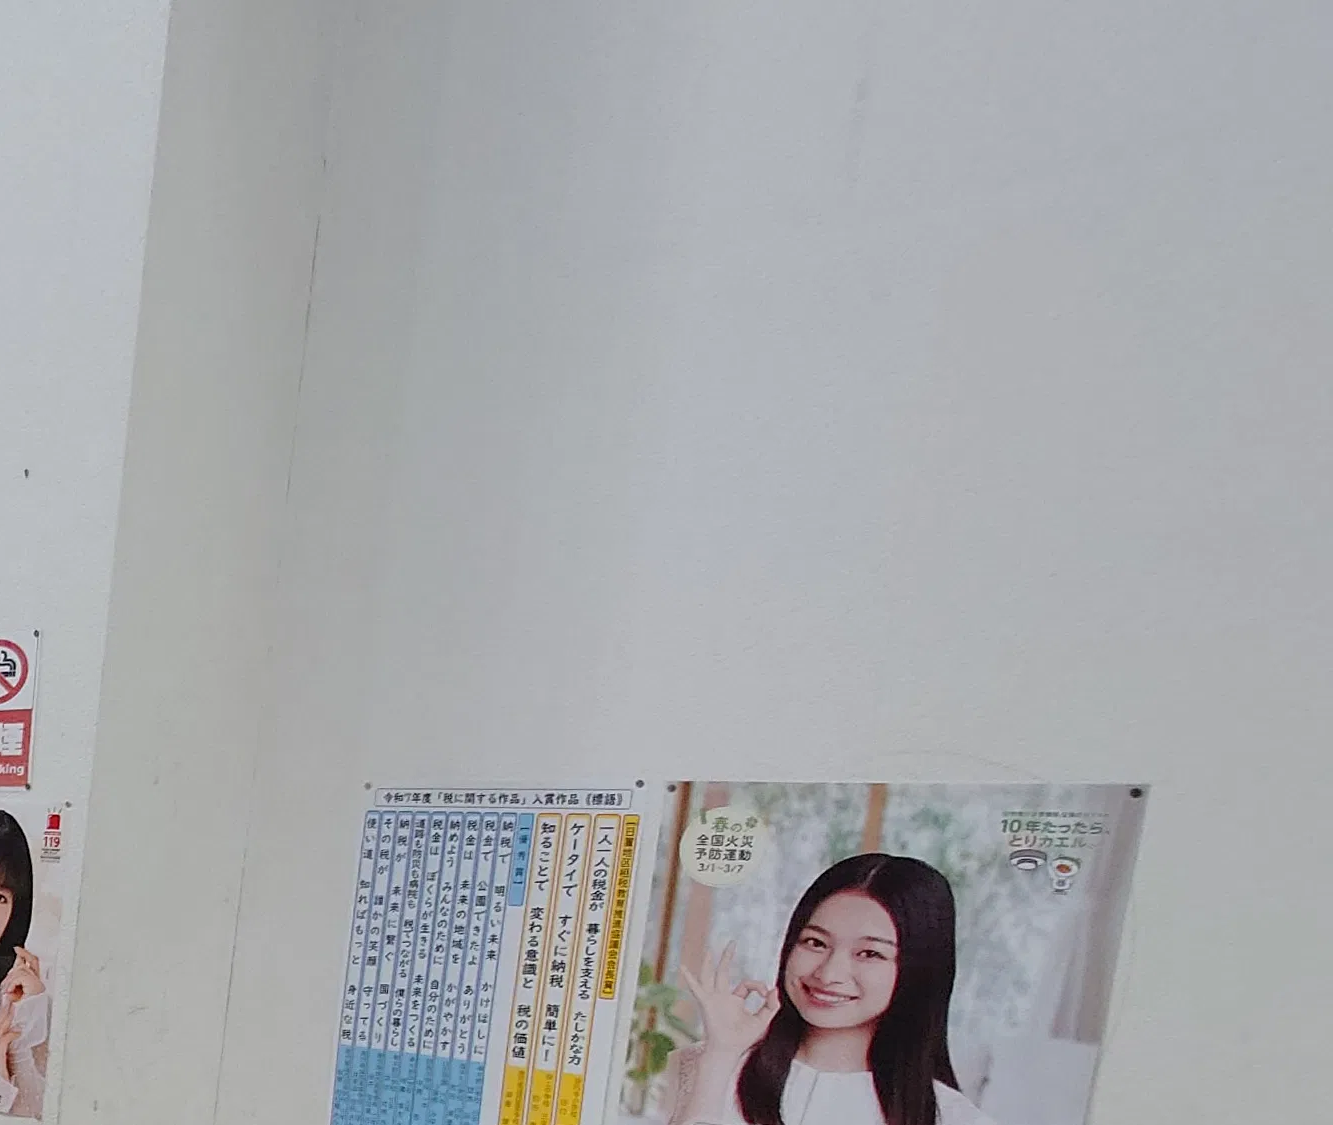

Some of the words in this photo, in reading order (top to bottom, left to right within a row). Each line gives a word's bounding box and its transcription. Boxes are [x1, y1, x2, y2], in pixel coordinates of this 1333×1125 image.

[44, 836, 60, 848] 119
[695, 848, 752, 861] 予防運動
[696, 834, 754, 848] 全国火災
[711, 816, 742, 832] 春の
[534, 823, 556, 892] 知ることで
[562, 823, 584, 897] ケータイで
[589, 827, 614, 912] 一人一人の税金が
[522, 907, 545, 989] 変わる意識と
[549, 915, 573, 988] すぐに納税
[578, 924, 600, 1000] 暮らしを支える
[512, 1004, 531, 1059] 税の価値
[568, 1012, 587, 1066] たしかな力
